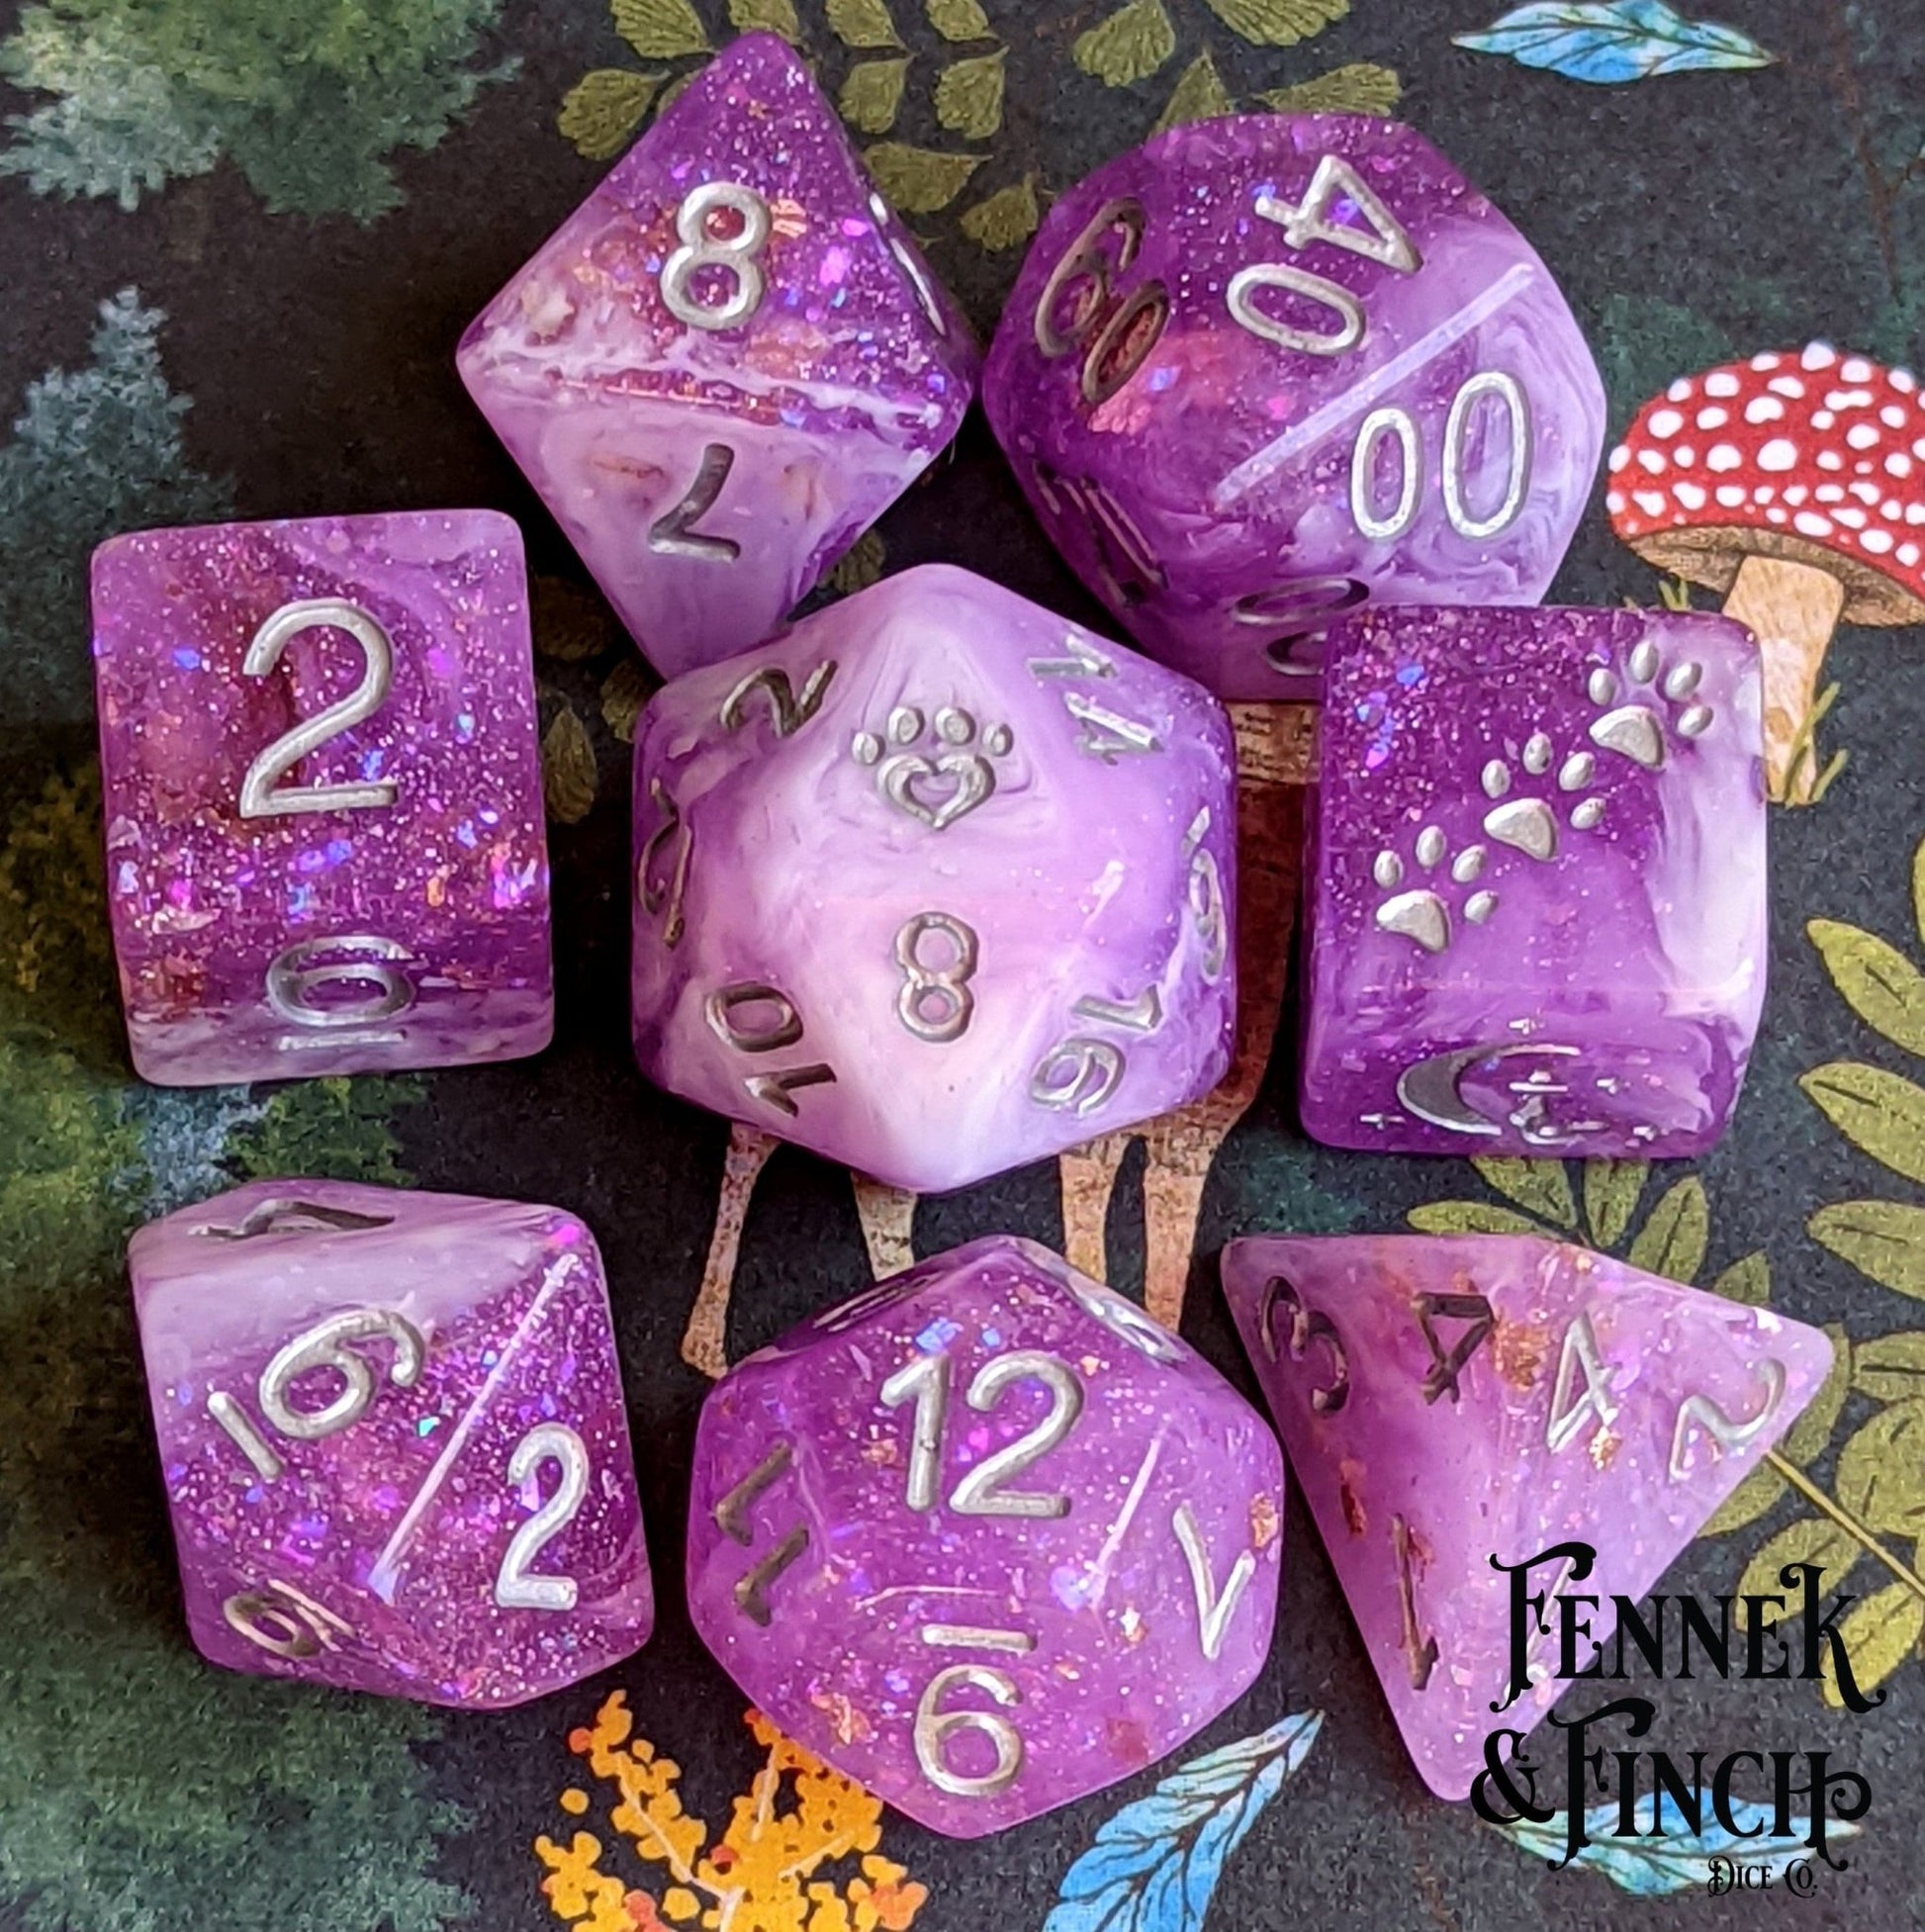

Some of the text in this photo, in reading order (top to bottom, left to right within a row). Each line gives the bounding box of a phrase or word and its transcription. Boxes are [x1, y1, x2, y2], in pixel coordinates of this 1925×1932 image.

[661, 181, 772, 329] 8
[1226, 154, 1423, 357] 40
[648, 442, 741, 563] 7
[1349, 371, 1534, 540] 00
[240, 597, 399, 818] 2
[719, 659, 838, 738] 2
[895, 911, 979, 1043] 8
[1414, 1290, 1496, 1405] 4
[1544, 1309, 1619, 1454] 4
[1669, 1357, 1788, 1484] 2
[880, 1349, 1086, 1518] 12
[495, 1422, 591, 1611] 2
